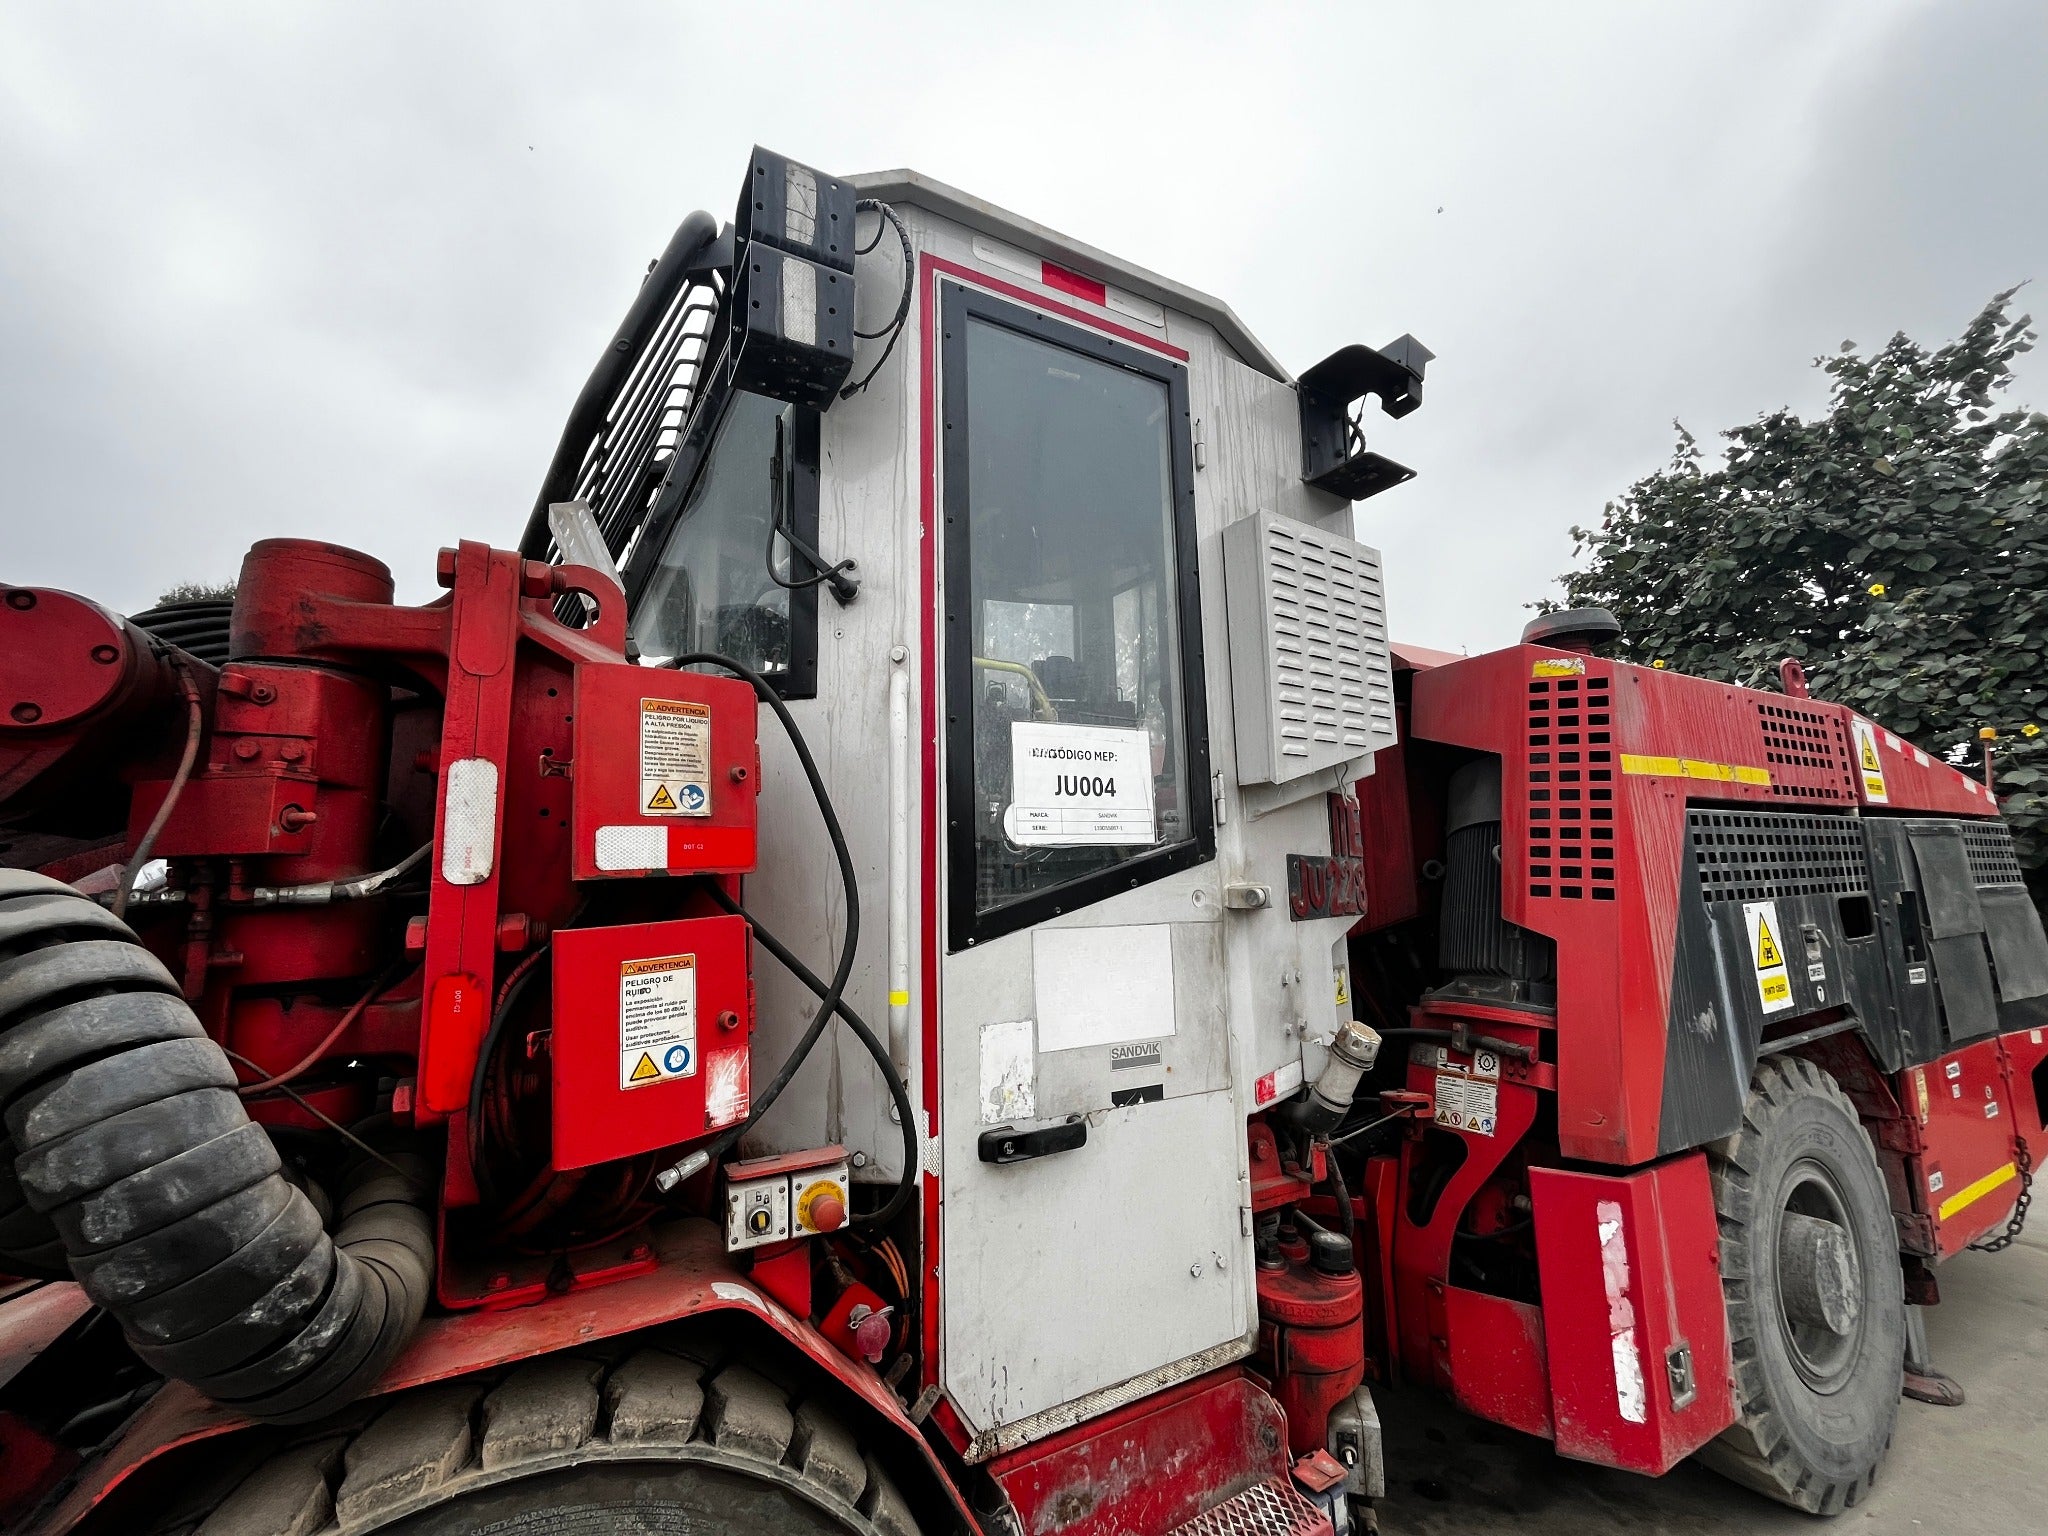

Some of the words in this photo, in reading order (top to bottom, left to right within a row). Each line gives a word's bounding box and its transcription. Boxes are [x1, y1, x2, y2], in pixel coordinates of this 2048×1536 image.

[656, 705, 706, 715] ADVERTENCIA
[1094, 751, 1118, 762] MEP:
[1054, 775, 1116, 797] JU004
[637, 960, 690, 972] ADVERTENCIA
[626, 977, 661, 988] PELIGRO
[453, 990, 462, 1013] DOT-C2
[1112, 1043, 1160, 1060] SANDVIK
[1440, 1050, 1445, 1059] L
